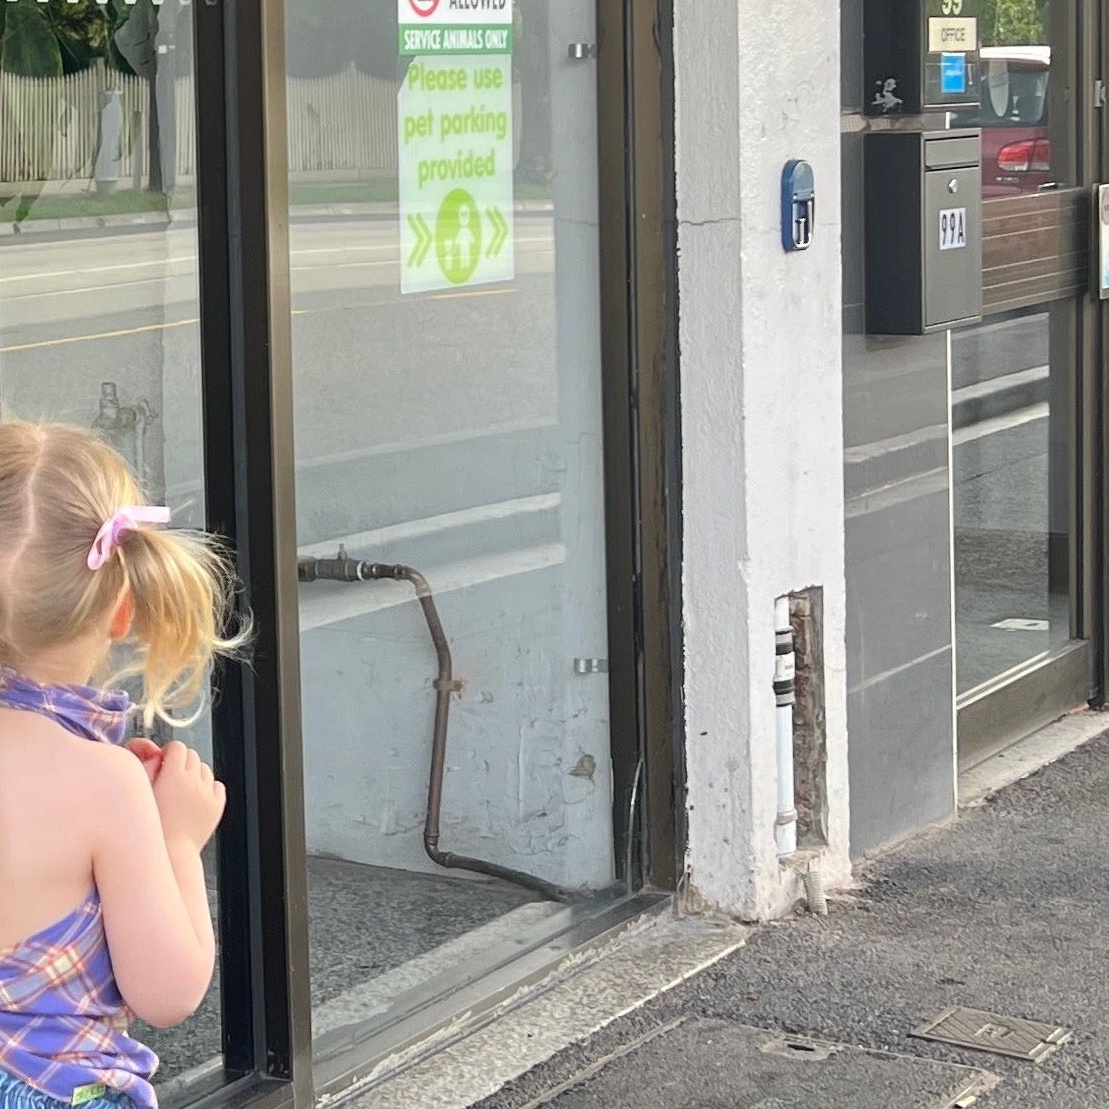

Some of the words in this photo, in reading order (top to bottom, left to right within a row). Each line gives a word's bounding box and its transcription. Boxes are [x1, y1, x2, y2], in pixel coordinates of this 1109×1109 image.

[404, 30, 441, 50] SERVICE
[443, 29, 484, 49] ANIMALS
[485, 29, 508, 48] ONLY
[942, 28, 966, 42] OFFICE
[408, 63, 467, 91] Please
[473, 67, 503, 90] use
[404, 108, 434, 145] pet
[441, 105, 507, 142] parking
[418, 149, 496, 190] provided
[941, 212, 964, 245] 99A
